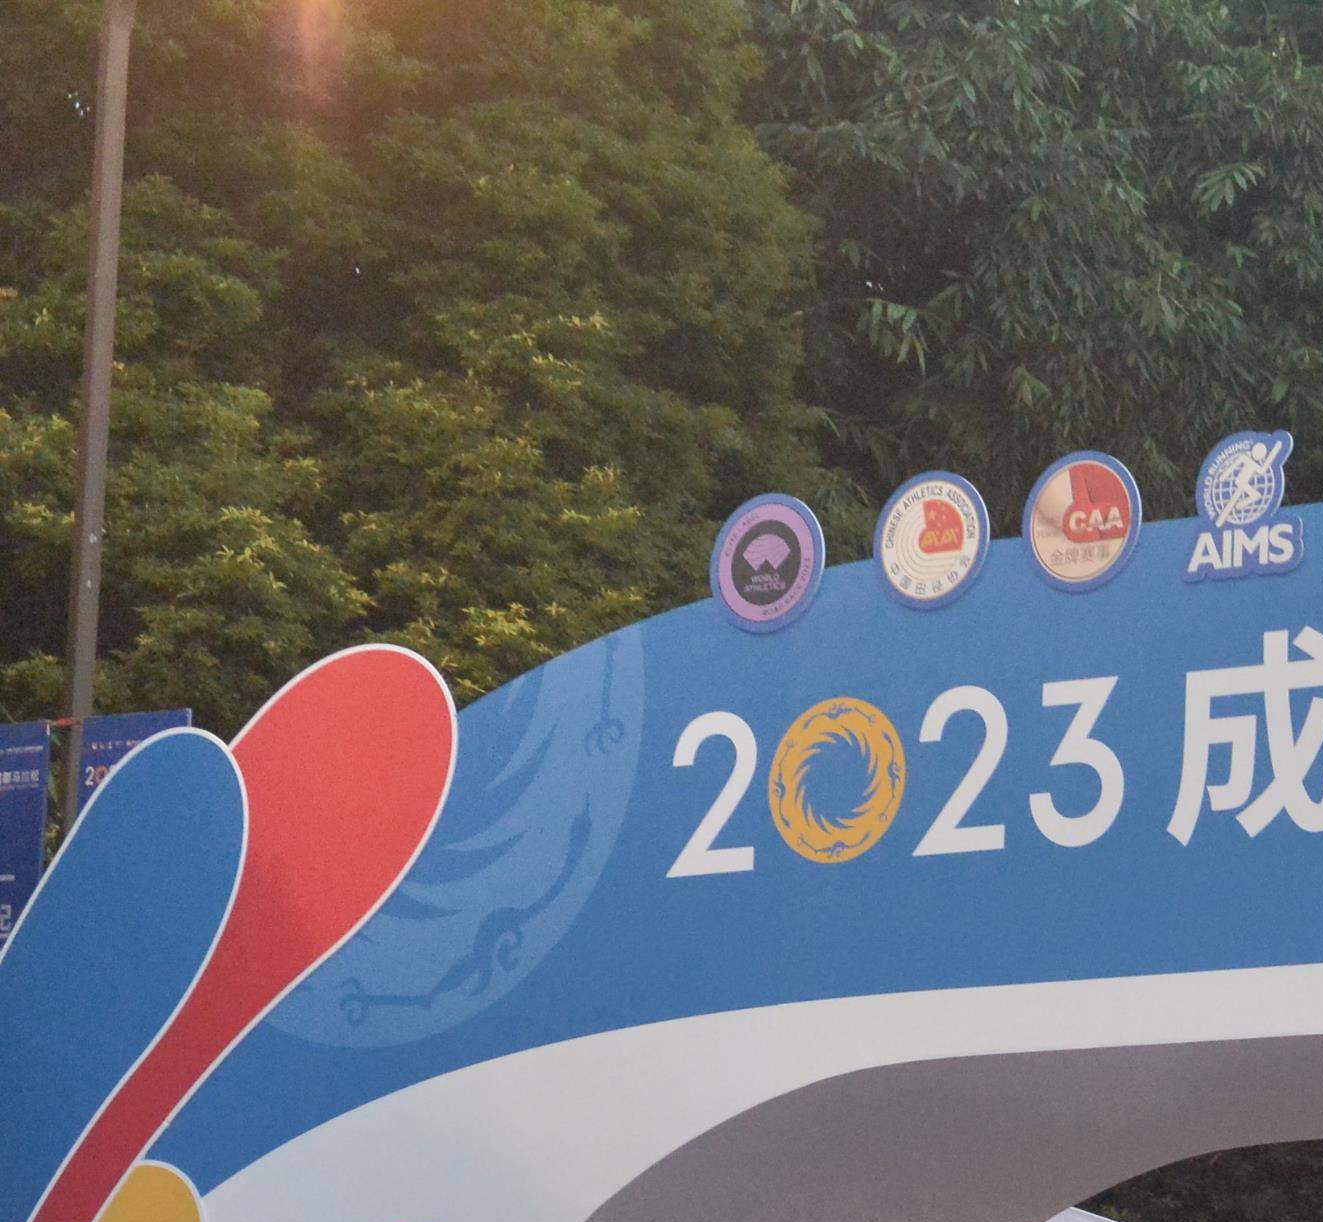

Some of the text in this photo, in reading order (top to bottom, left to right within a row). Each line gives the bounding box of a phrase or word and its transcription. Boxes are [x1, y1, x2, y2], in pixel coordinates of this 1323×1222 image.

[1069, 506, 1123, 531] CAA
[1187, 523, 1294, 573] AIMS
[666, 675, 1125, 880] 2023
